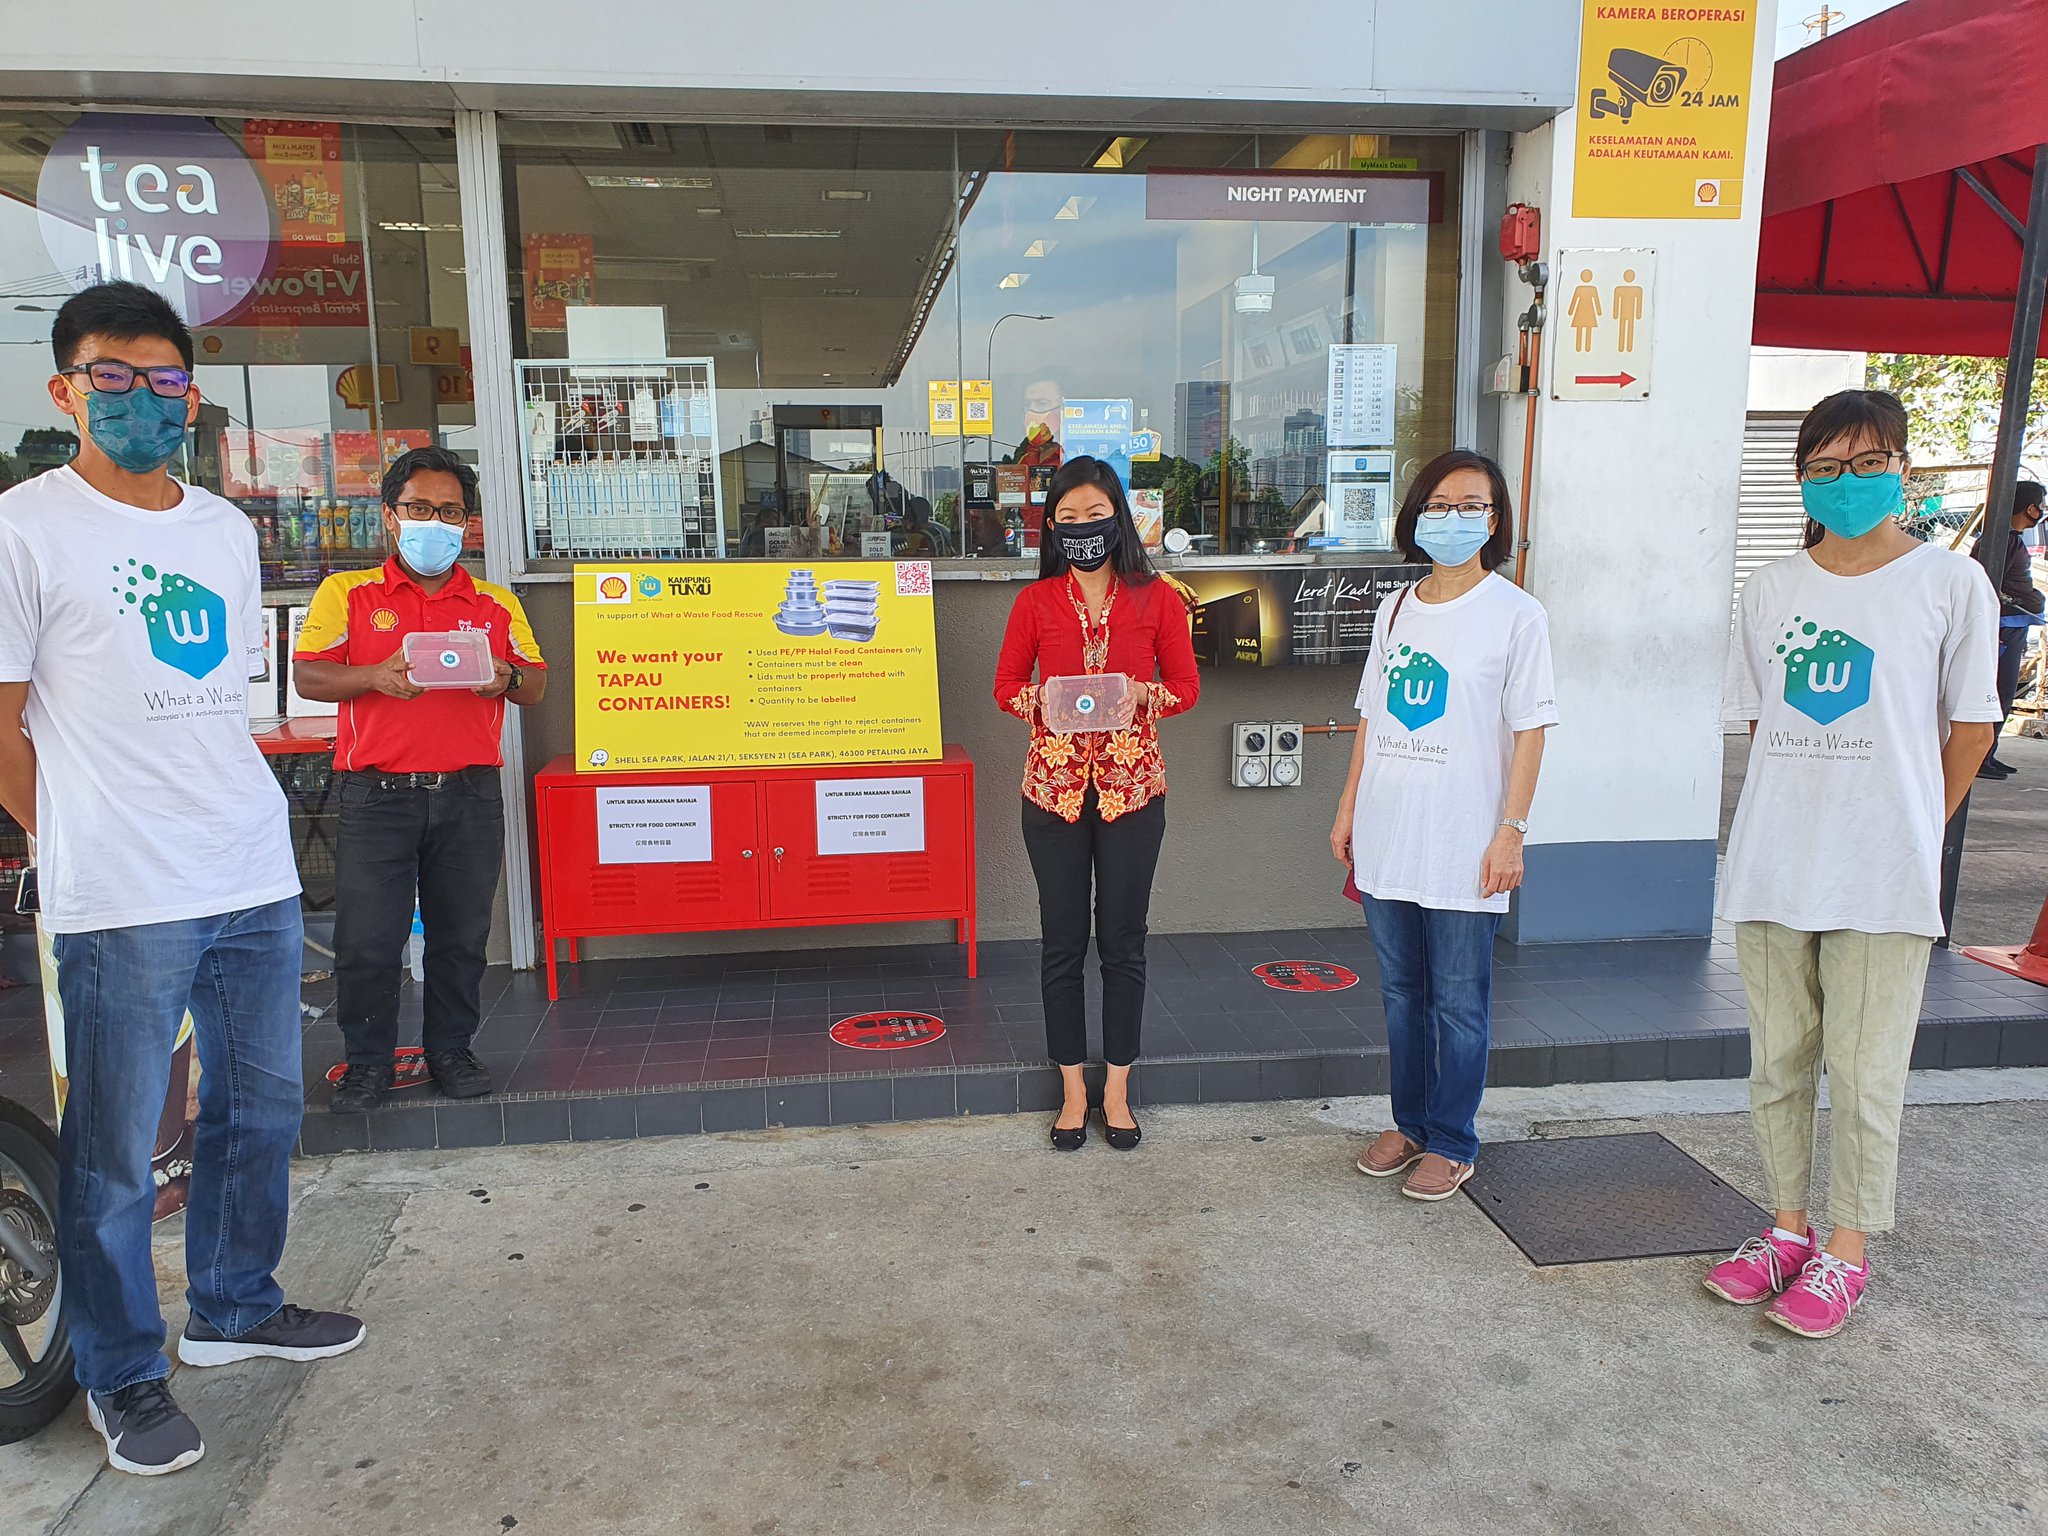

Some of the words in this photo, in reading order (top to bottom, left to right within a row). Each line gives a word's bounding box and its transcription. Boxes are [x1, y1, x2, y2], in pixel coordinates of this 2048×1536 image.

[1597, 6, 1656, 20] KAMERA
[1661, 8, 1745, 22] BEROPERASI
[1680, 91, 1704, 107] 24
[1708, 94, 1740, 108] JAM
[1588, 135, 1663, 146] KESELAMATAN
[1666, 136, 1697, 146] ANDA
[1588, 149, 1630, 158] ADALAH
[1634, 150, 1699, 159] KEUTAMAAN
[1702, 150, 1733, 159] KAMI.
[1361, 161, 1388, 169] MyMaxis
[80, 146, 219, 214] tea
[1227, 186, 1283, 202] NIGHT
[1288, 188, 1367, 204] PAYMENT
[96, 217, 225, 284] live
[1062, 535, 1103, 546] KAMPUNG
[1064, 544, 1105, 560] TUNKU
[668, 576, 710, 584] KAMPUNG
[1376, 581, 1392, 589] RHB
[1393, 580, 1409, 588] Shell
[668, 584, 711, 596] TUNKU
[1294, 578, 1334, 603] Leret
[1333, 576, 1371, 605] Kad
[607, 612, 638, 620] support
[1235, 638, 1258, 647] VISA
[780, 648, 807, 657] PE/PP
[905, 646, 922, 654] only
[597, 650, 627, 663] We
[632, 650, 678, 662] want
[683, 652, 723, 666] your
[757, 660, 803, 668] Containers
[597, 673, 662, 687] TAPAU
[810, 672, 846, 681] properly
[144, 690, 193, 711] What
[196, 695, 204, 704] a
[598, 695, 730, 711] CONTAINERS!
[758, 697, 794, 705] Quantity
[147, 712, 184, 722] Malaysia's
[824, 719, 842, 728] right
[856, 718, 878, 726] reject
[778, 729, 810, 737] deemed
[812, 728, 856, 736] incomplete
[1377, 735, 1401, 749] What
[1412, 738, 1448, 754] Waste
[1769, 731, 1810, 748] What
[1826, 733, 1873, 751] Waste
[661, 755, 686, 763] PARK,
[688, 754, 715, 762] JALAN
[717, 754, 736, 762] 21/1,
[788, 752, 807, 760] (SEA
[810, 750, 837, 759] PARK),
[867, 748, 905, 756] PETALING
